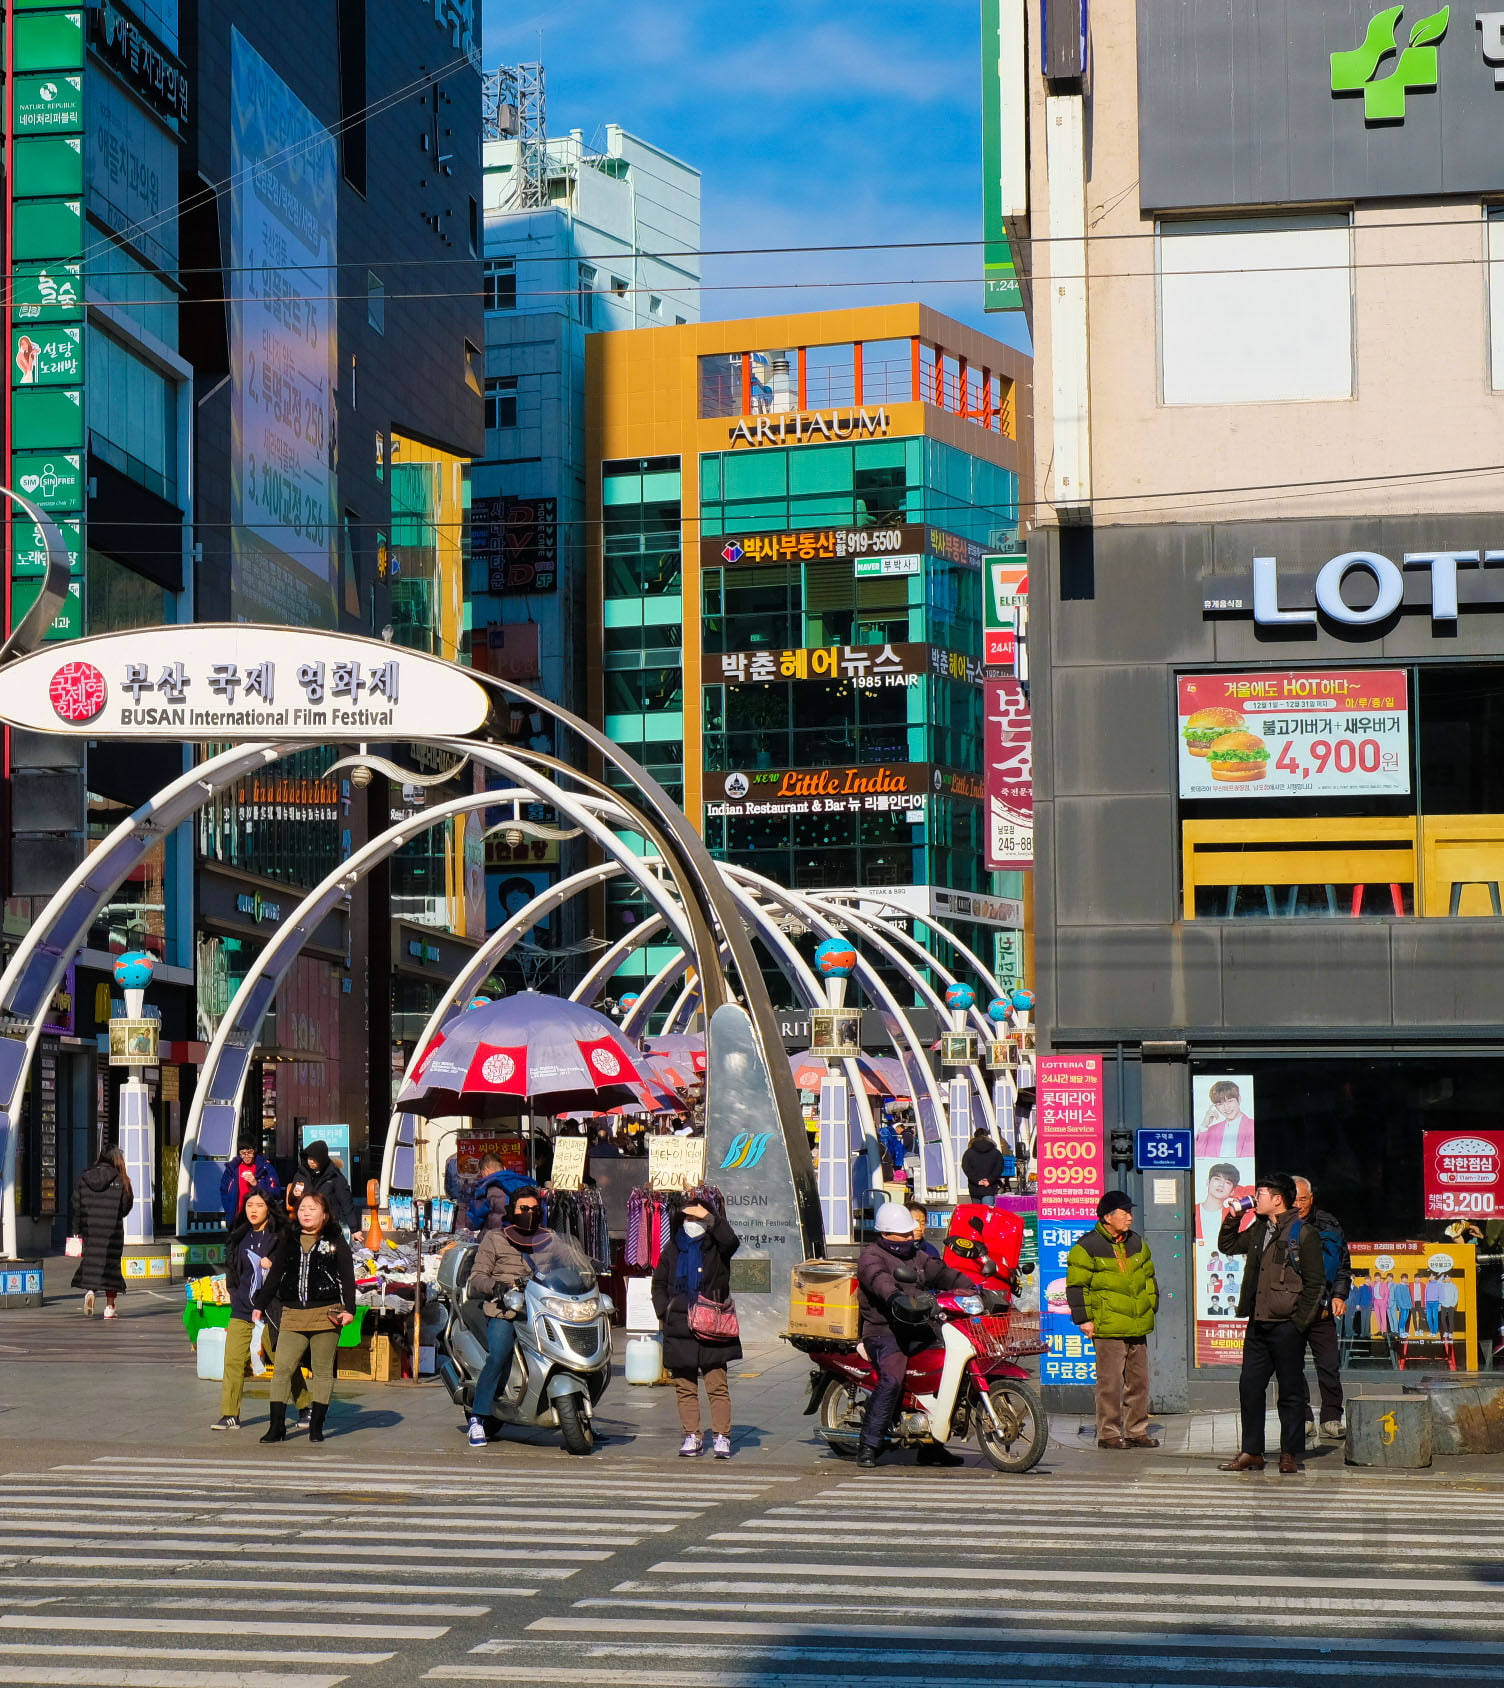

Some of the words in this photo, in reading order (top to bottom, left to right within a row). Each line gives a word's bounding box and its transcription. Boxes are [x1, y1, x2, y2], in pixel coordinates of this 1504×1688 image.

[19, 112, 78, 125] 네이처리퍼블릭
[262, 259, 302, 337] 임플란트
[43, 341, 74, 357] 설탕
[40, 359, 78, 375] 노래방
[262, 361, 302, 439] 투명교정
[304, 398, 324, 450] 250
[731, 407, 888, 448] ARITAUM
[57, 477, 75, 486] FREE
[262, 464, 302, 537] 치아교정
[743, 531, 835, 563] 박사부동산
[847, 530, 902, 553] 919-5500
[930, 529, 967, 565] 박사부동산
[16, 551, 78, 566] 노래장
[858, 563, 880, 572] NAVER
[1253, 550, 1504, 625] LOT
[1203, 600, 1244, 609] 휴게음식점
[721, 644, 904, 682] 박춘헤어뉴스
[931, 648, 985, 685] 박춘헤어뉴스
[120, 661, 191, 704] 부산
[207, 661, 275, 704] 국제
[297, 661, 399, 705] 영화제
[851, 676, 882, 689] 1985
[885, 674, 919, 688] HAIR
[1224, 681, 1278, 698] 겨울에도
[120, 708, 185, 726] BUSAN
[190, 708, 288, 726] International
[294, 708, 327, 726] Film
[332, 708, 394, 726] Festival
[753, 772, 780, 785] NEW
[777, 770, 840, 797] Little
[840, 767, 908, 795] India
[707, 803, 744, 817] Indian
[745, 799, 809, 815] Restaurant
[811, 799, 823, 812] &
[824, 798, 846, 811] Bar
[847, 797, 862, 812] 뉴
[864, 794, 927, 811] 리틀인디아
[997, 825, 1015, 835] 남포점
[998, 837, 1032, 851] 245-88
[1042, 1074, 1068, 1084] 24시간
[1042, 1092, 1096, 1107] 롯데리아
[1042, 1109, 1097, 1124] 홈서비스
[1044, 1141, 1096, 1159] 1600
[1147, 1142, 1182, 1157] 58-1
[1443, 1157, 1492, 1171] 착한점심
[1044, 1166, 1097, 1184] 9999
[727, 1195, 768, 1206] BUSAN
[1443, 1192, 1494, 1212] 3,200
[766, 1219, 791, 1227] Festival
[737, 1234, 786, 1248] 제영화제
